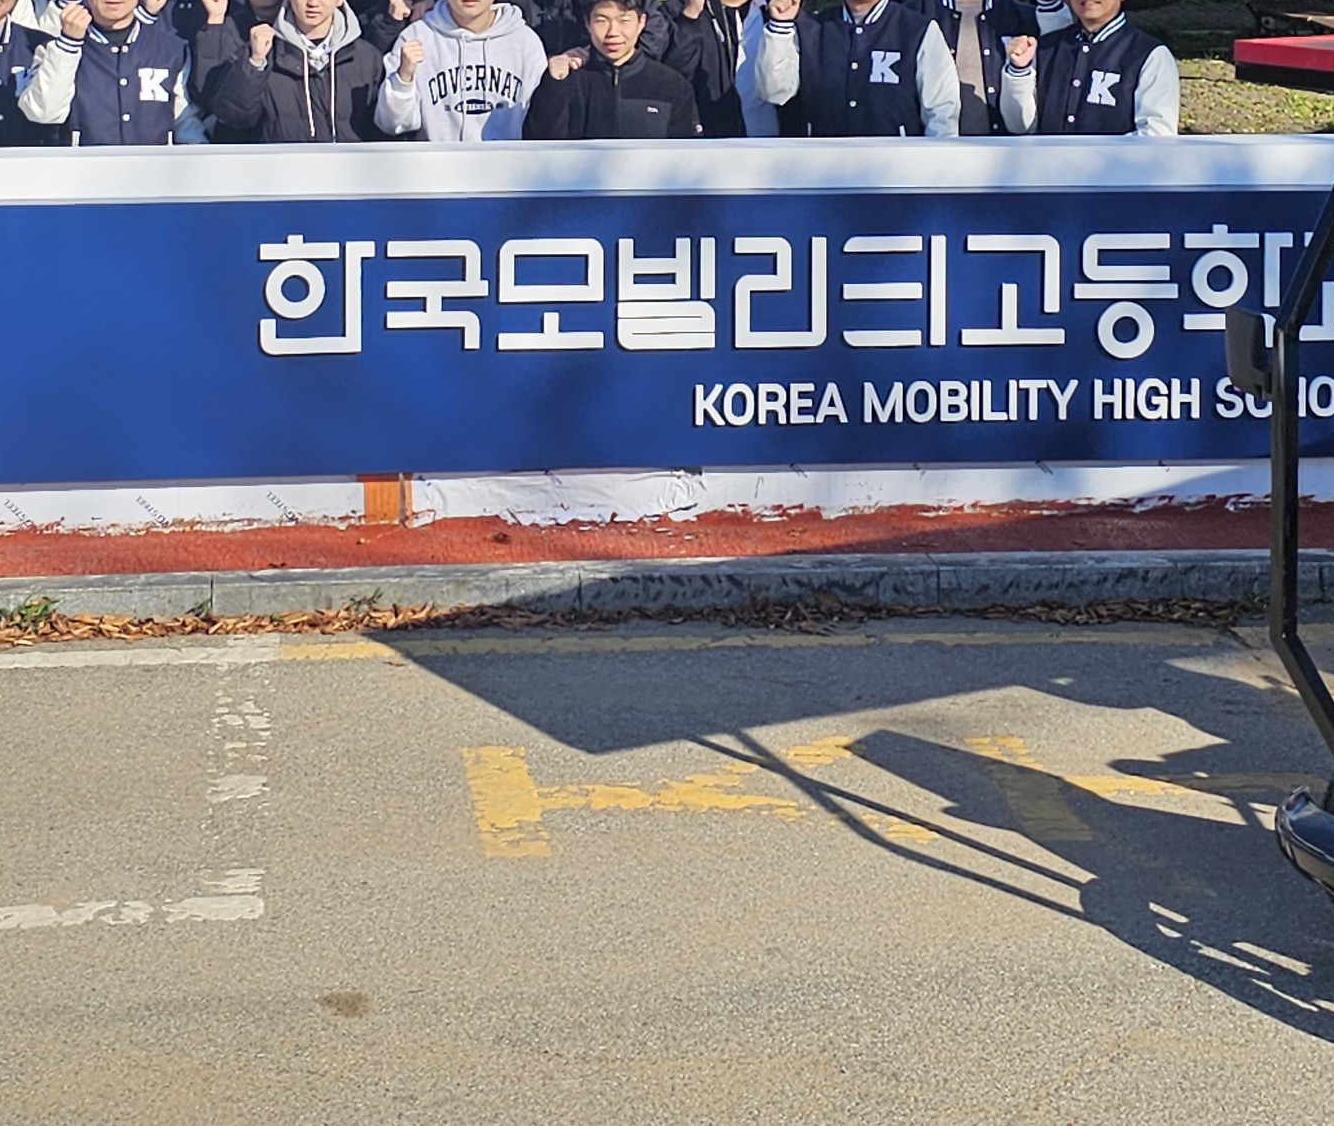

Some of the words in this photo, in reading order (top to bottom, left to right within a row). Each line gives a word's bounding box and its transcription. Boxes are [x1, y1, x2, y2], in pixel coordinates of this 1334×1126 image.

[138, 67, 171, 103] K
[868, 50, 902, 84] K
[428, 65, 523, 106] COVERNAT
[1086, 70, 1121, 106] K
[695, 382, 848, 428] KOREA
[864, 378, 1078, 424] MOBILITY
[1094, 376, 1201, 421] HIGH
